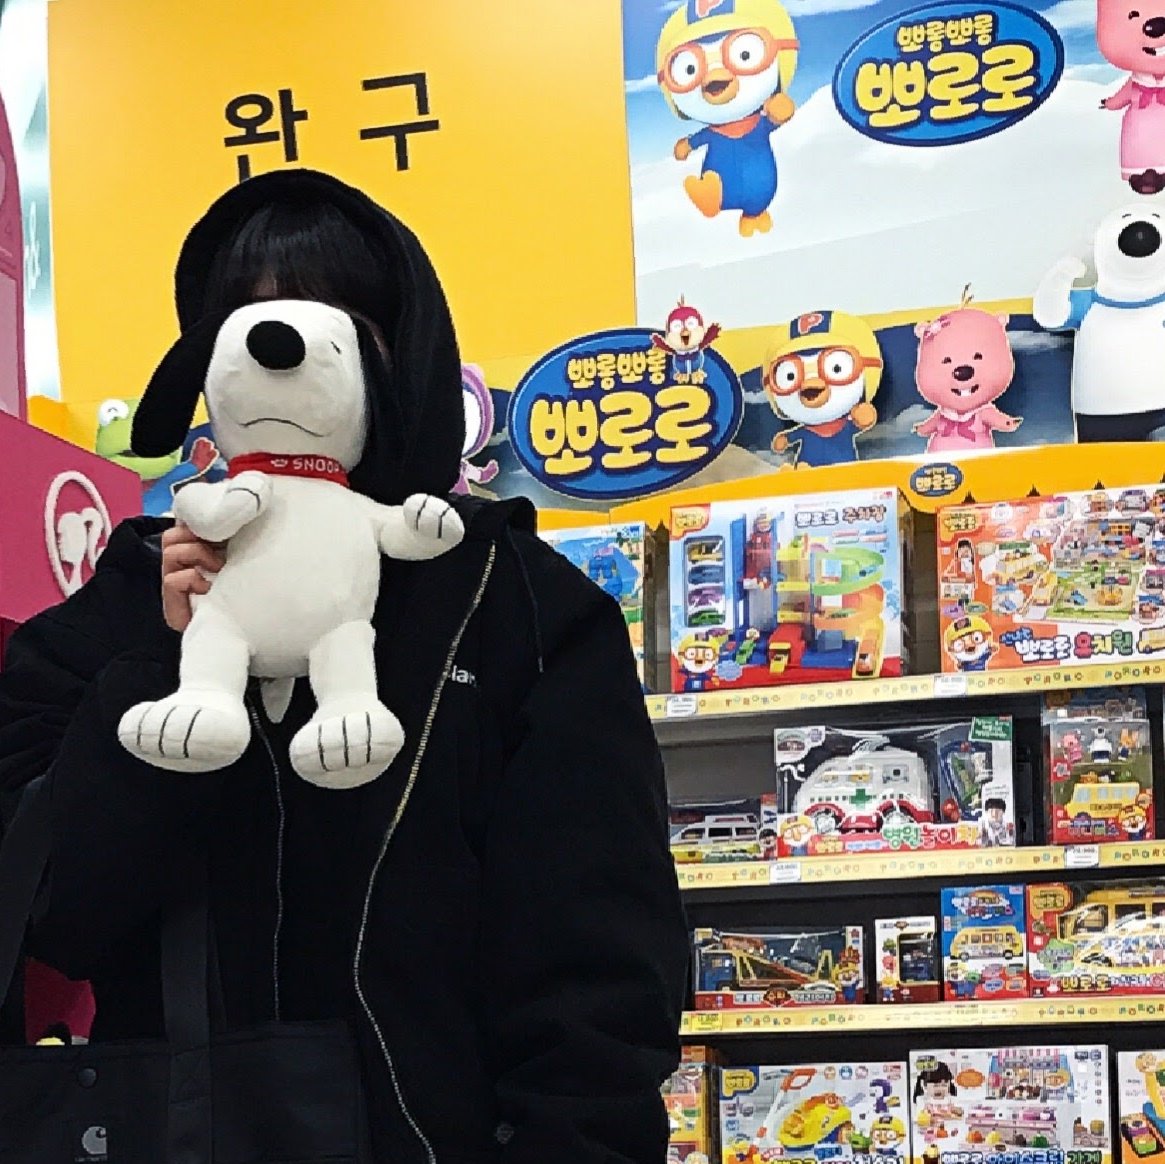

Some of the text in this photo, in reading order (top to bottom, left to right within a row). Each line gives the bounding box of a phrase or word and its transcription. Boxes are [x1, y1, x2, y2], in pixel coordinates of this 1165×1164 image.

[897, 14, 993, 52] 뽀롱뽀롱
[855, 44, 1036, 128] 뽀로로
[567, 349, 666, 390] 뽀롱뽀롱
[530, 385, 712, 475] 뽀로로
[1074, 629, 1134, 660] 유치원
